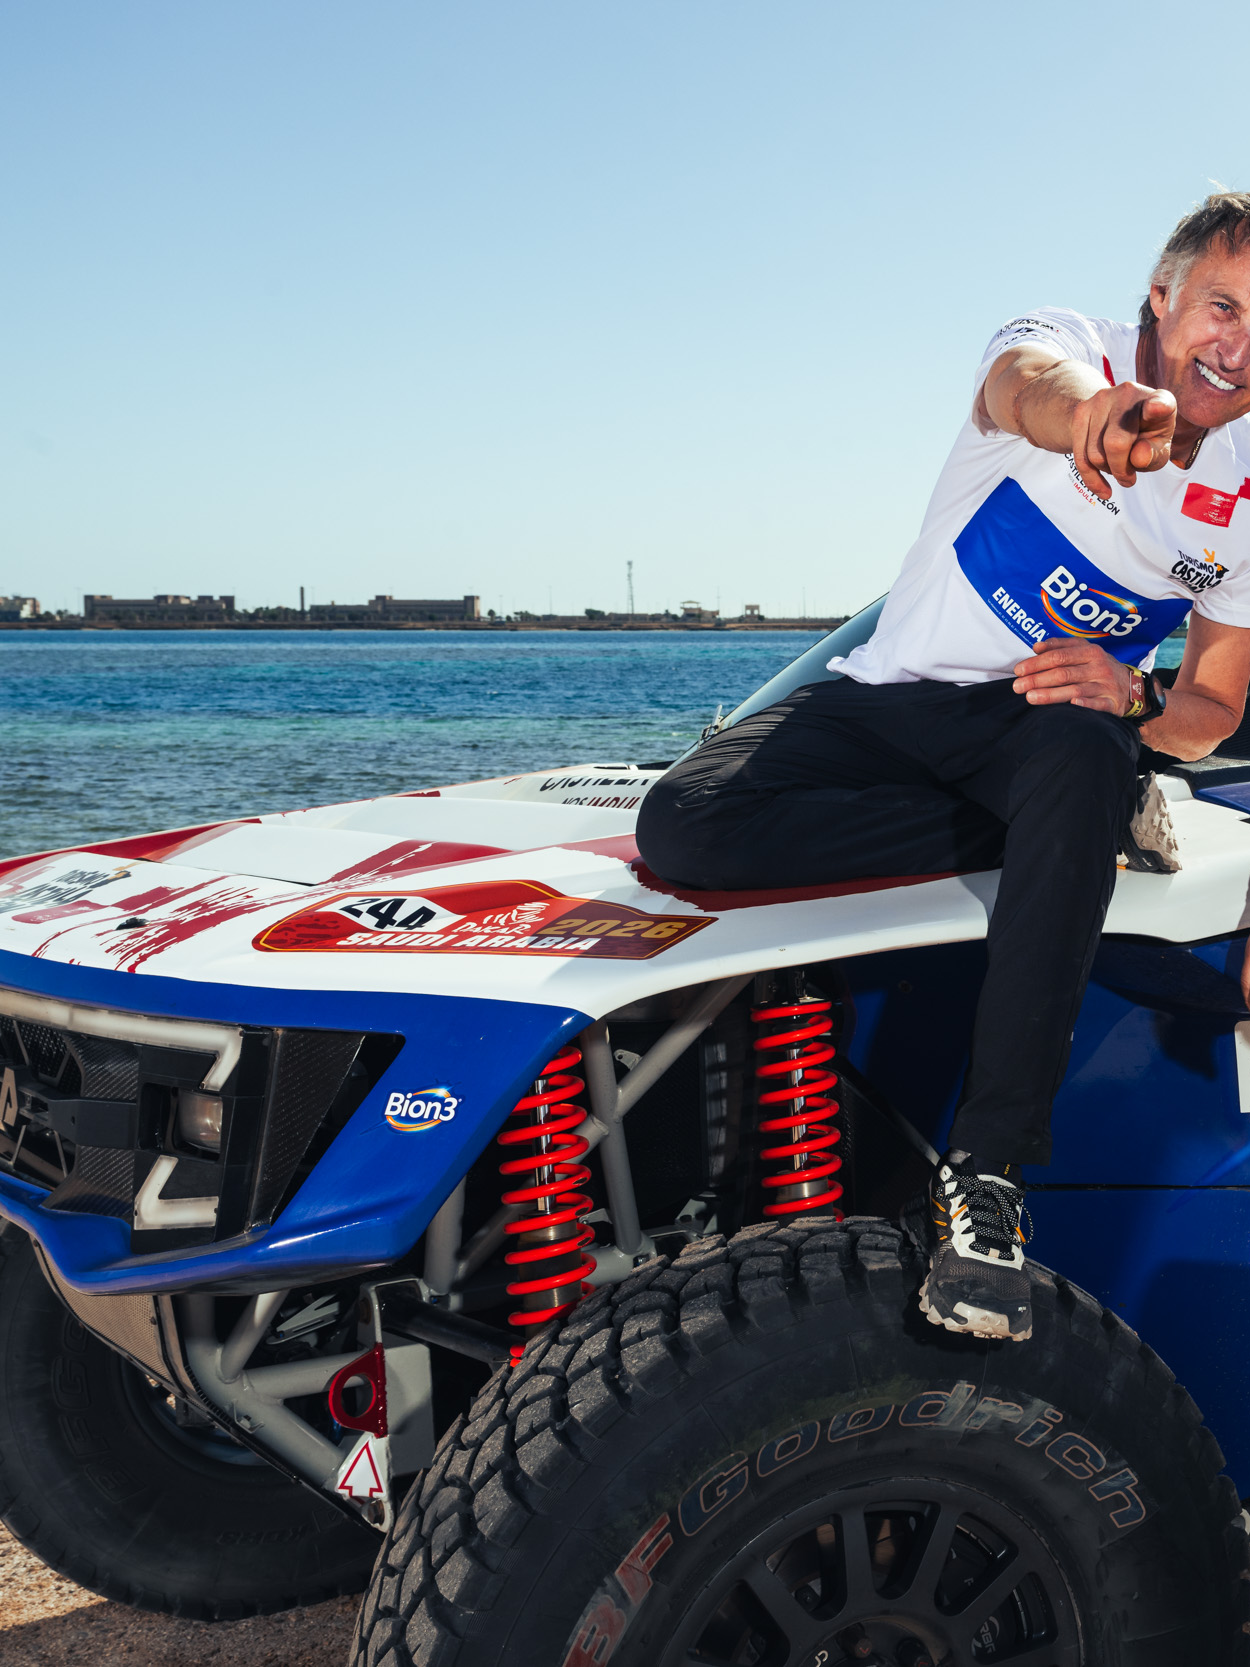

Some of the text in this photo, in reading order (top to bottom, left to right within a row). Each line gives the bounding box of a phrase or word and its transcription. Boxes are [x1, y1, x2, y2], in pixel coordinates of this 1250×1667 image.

[342, 897, 437, 931] 244
[451, 923, 532, 936] DAKAR
[536, 918, 688, 939] 2026
[336, 932, 602, 951] SAUDI ARABIA
